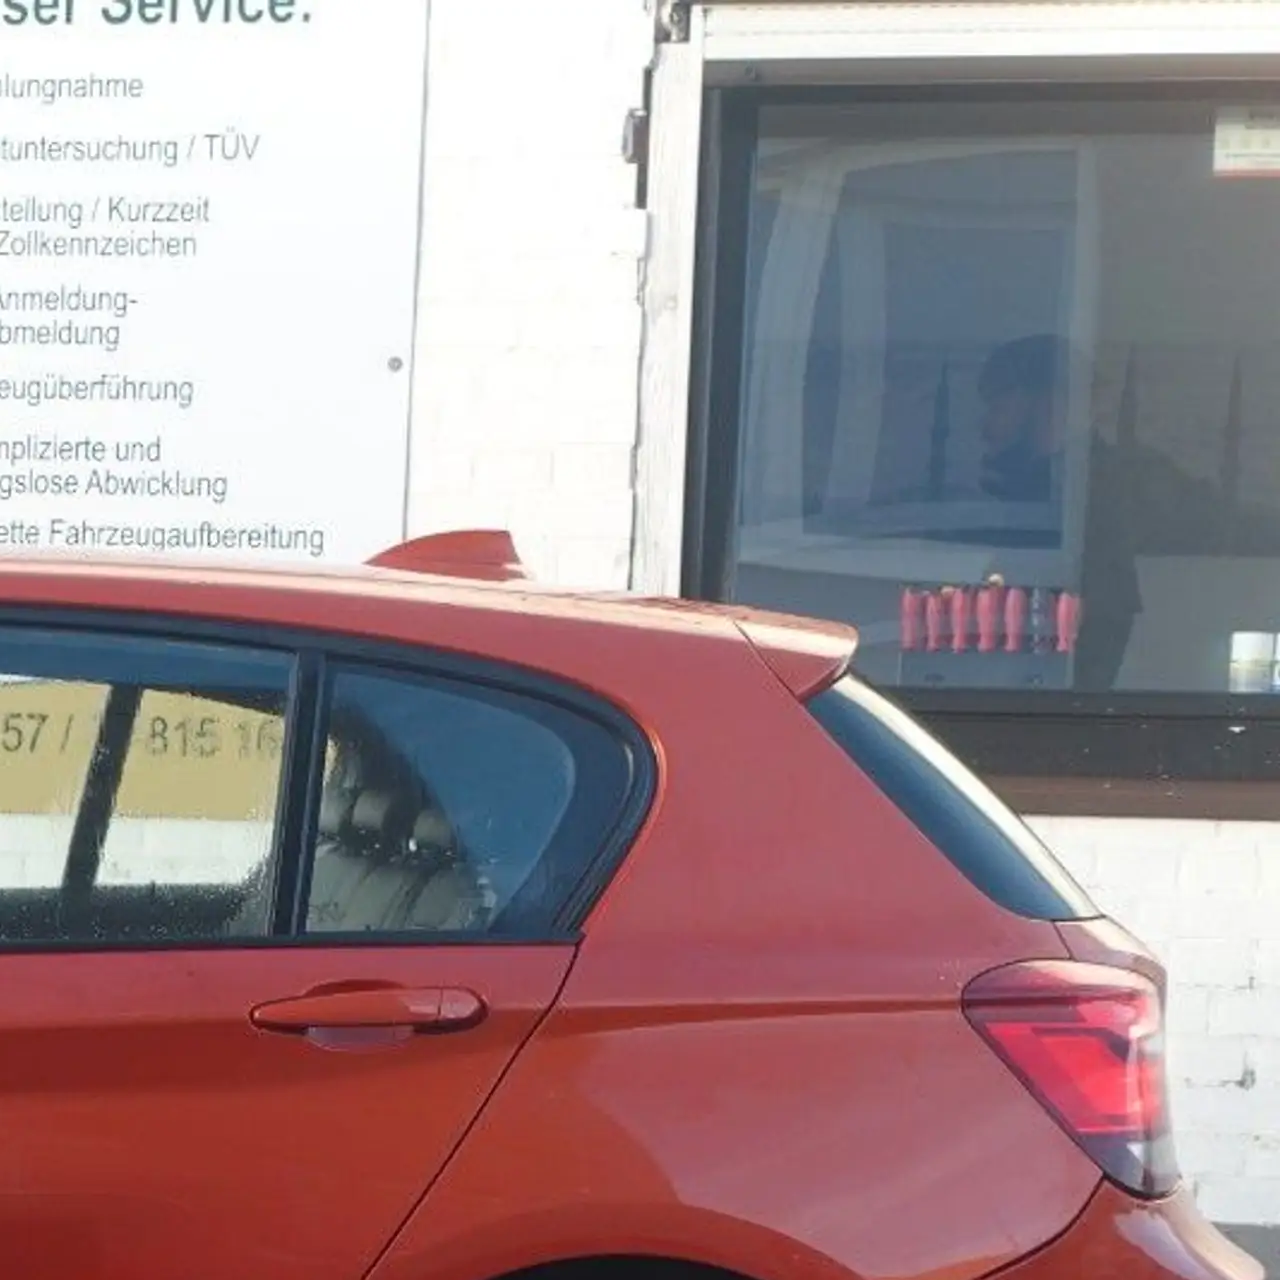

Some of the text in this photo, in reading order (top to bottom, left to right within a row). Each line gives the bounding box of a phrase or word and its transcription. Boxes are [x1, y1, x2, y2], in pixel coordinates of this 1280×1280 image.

[203, 126, 260, 161] TÜV
[108, 196, 210, 223] Kurzzeit
[114, 436, 161, 462] und
[85, 470, 228, 504] Abwicklung
[48, 518, 325, 556] Fahrzeugaufbereitung
